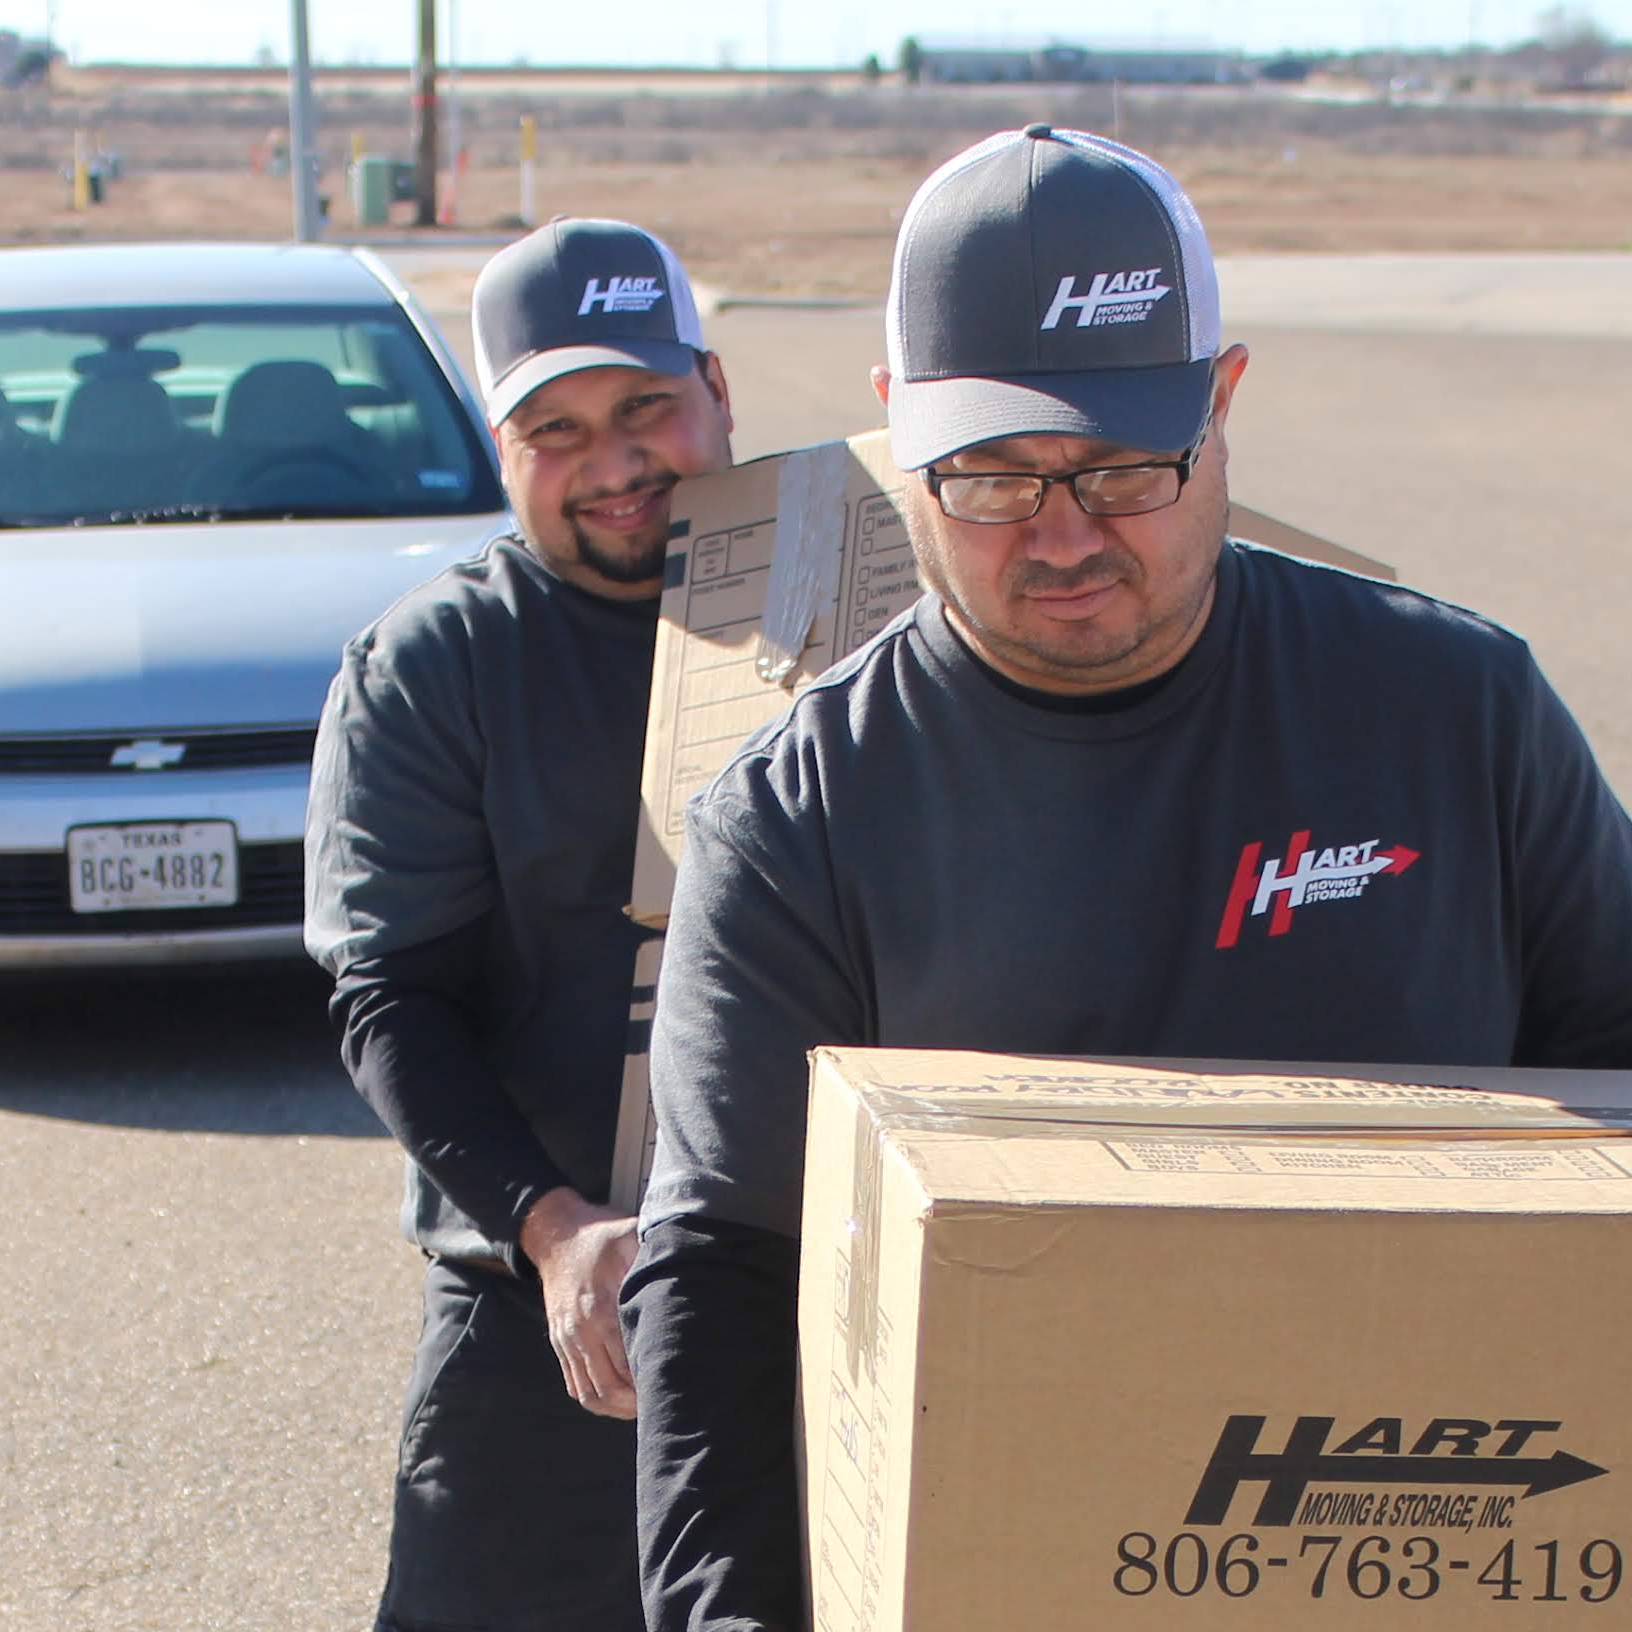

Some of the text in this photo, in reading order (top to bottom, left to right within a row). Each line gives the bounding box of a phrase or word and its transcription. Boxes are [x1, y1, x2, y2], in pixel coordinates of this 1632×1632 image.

[577, 276, 657, 316] HART
[1040, 268, 1163, 330] HART
[1096, 303, 1144, 317] MOVING
[1093, 311, 1148, 326] STORAGE
[122, 833, 183, 848] TEXAS
[1251, 838, 1380, 916] HART
[1307, 876, 1369, 893] MOVING &
[1305, 887, 1363, 904] STORAGE
[1183, 1415, 1563, 1526] HART
[1298, 1492, 1515, 1534] MOVING & STORAGE, INC.
